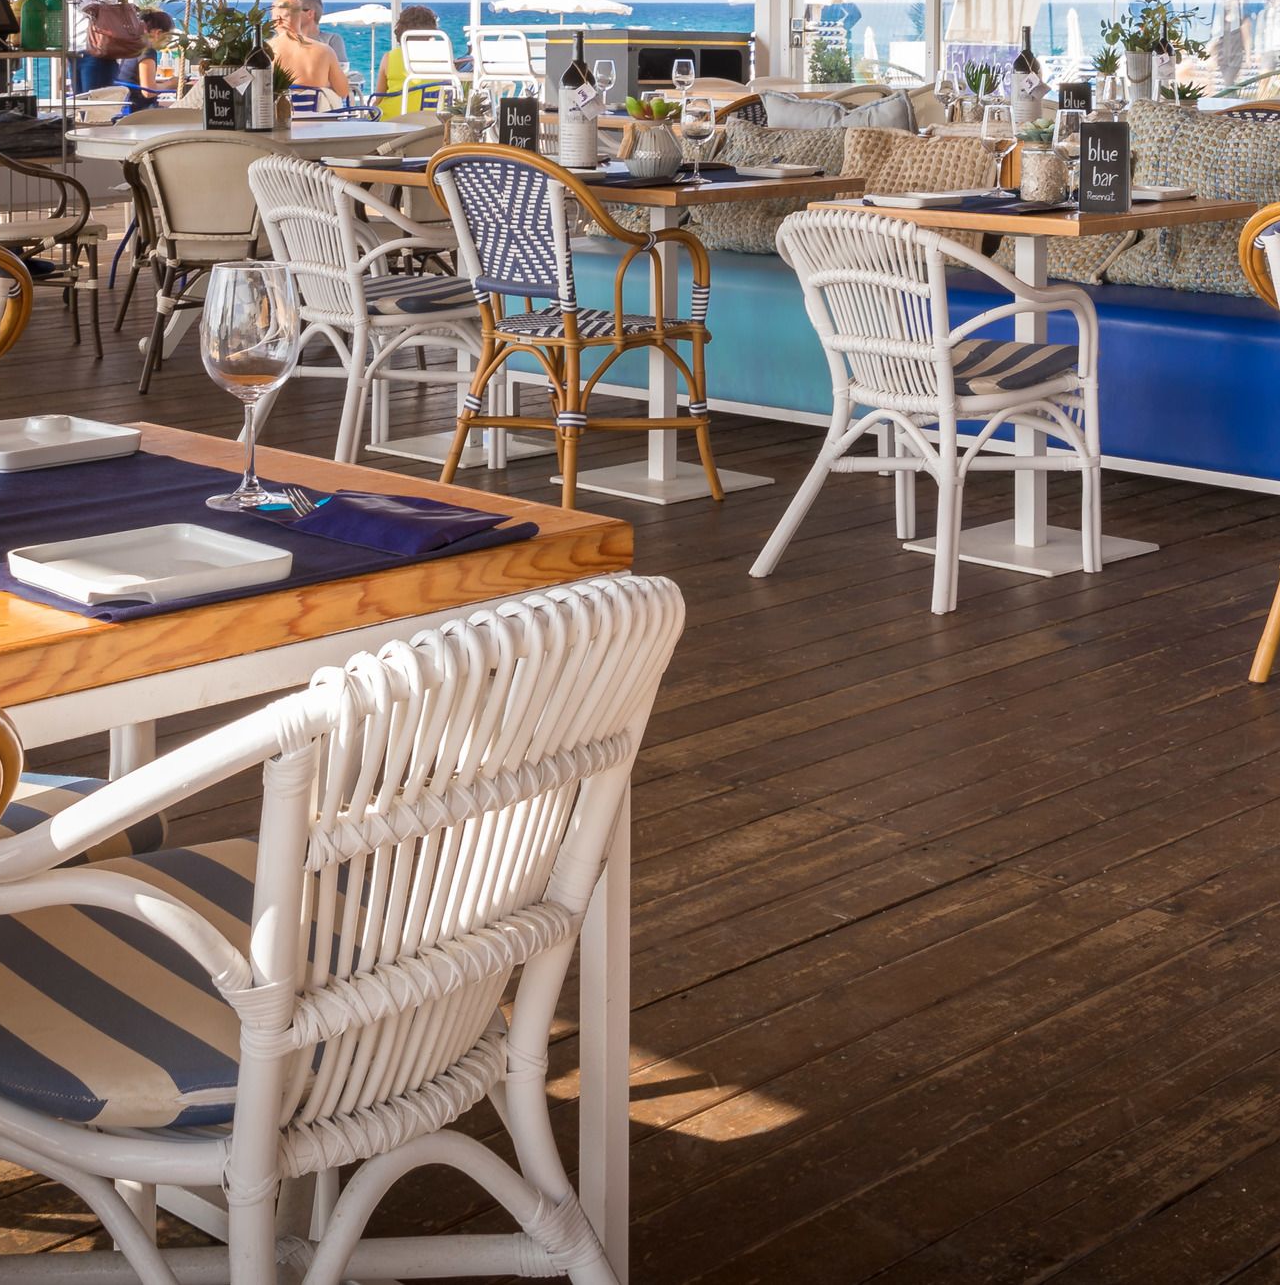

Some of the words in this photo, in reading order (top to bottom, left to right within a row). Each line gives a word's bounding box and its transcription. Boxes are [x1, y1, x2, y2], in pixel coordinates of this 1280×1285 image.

[208, 84, 231, 100] blue
[1063, 90, 1086, 109] blue
[213, 101, 231, 117] bar
[506, 107, 532, 126] blue
[509, 128, 531, 148] bar
[1087, 136, 1119, 162] blue
[1092, 165, 1119, 187] bar
